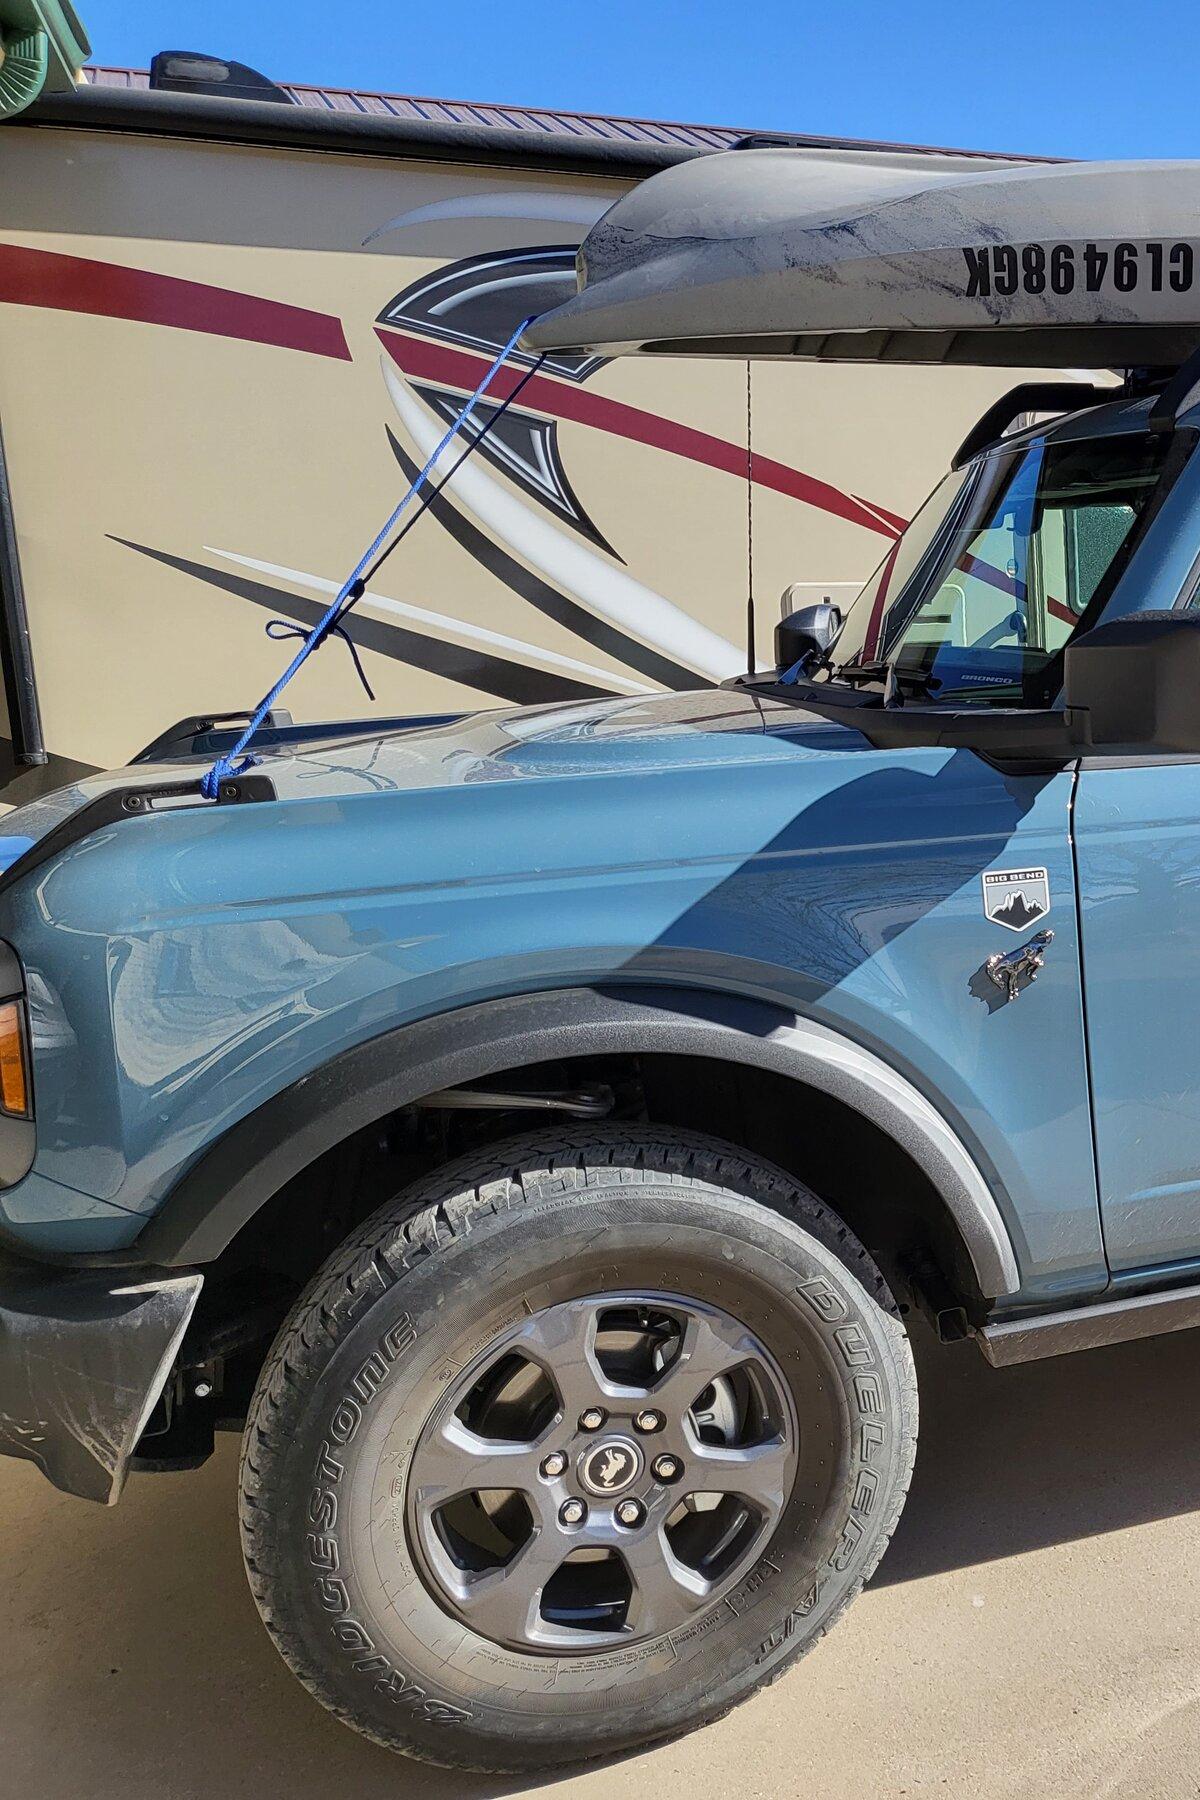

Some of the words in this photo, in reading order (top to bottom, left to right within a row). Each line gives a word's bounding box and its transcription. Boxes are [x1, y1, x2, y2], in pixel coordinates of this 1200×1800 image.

[962, 242, 1193, 297] CL9498GK
[960, 674, 1013, 684] BRONCO
[986, 874, 1008, 883] BIG
[1010, 872, 1044, 881] BEND
[797, 1274, 886, 1573] DUELER
[306, 1311, 474, 1724] BRIDGESTONE
[755, 1579, 823, 1666] A/T
